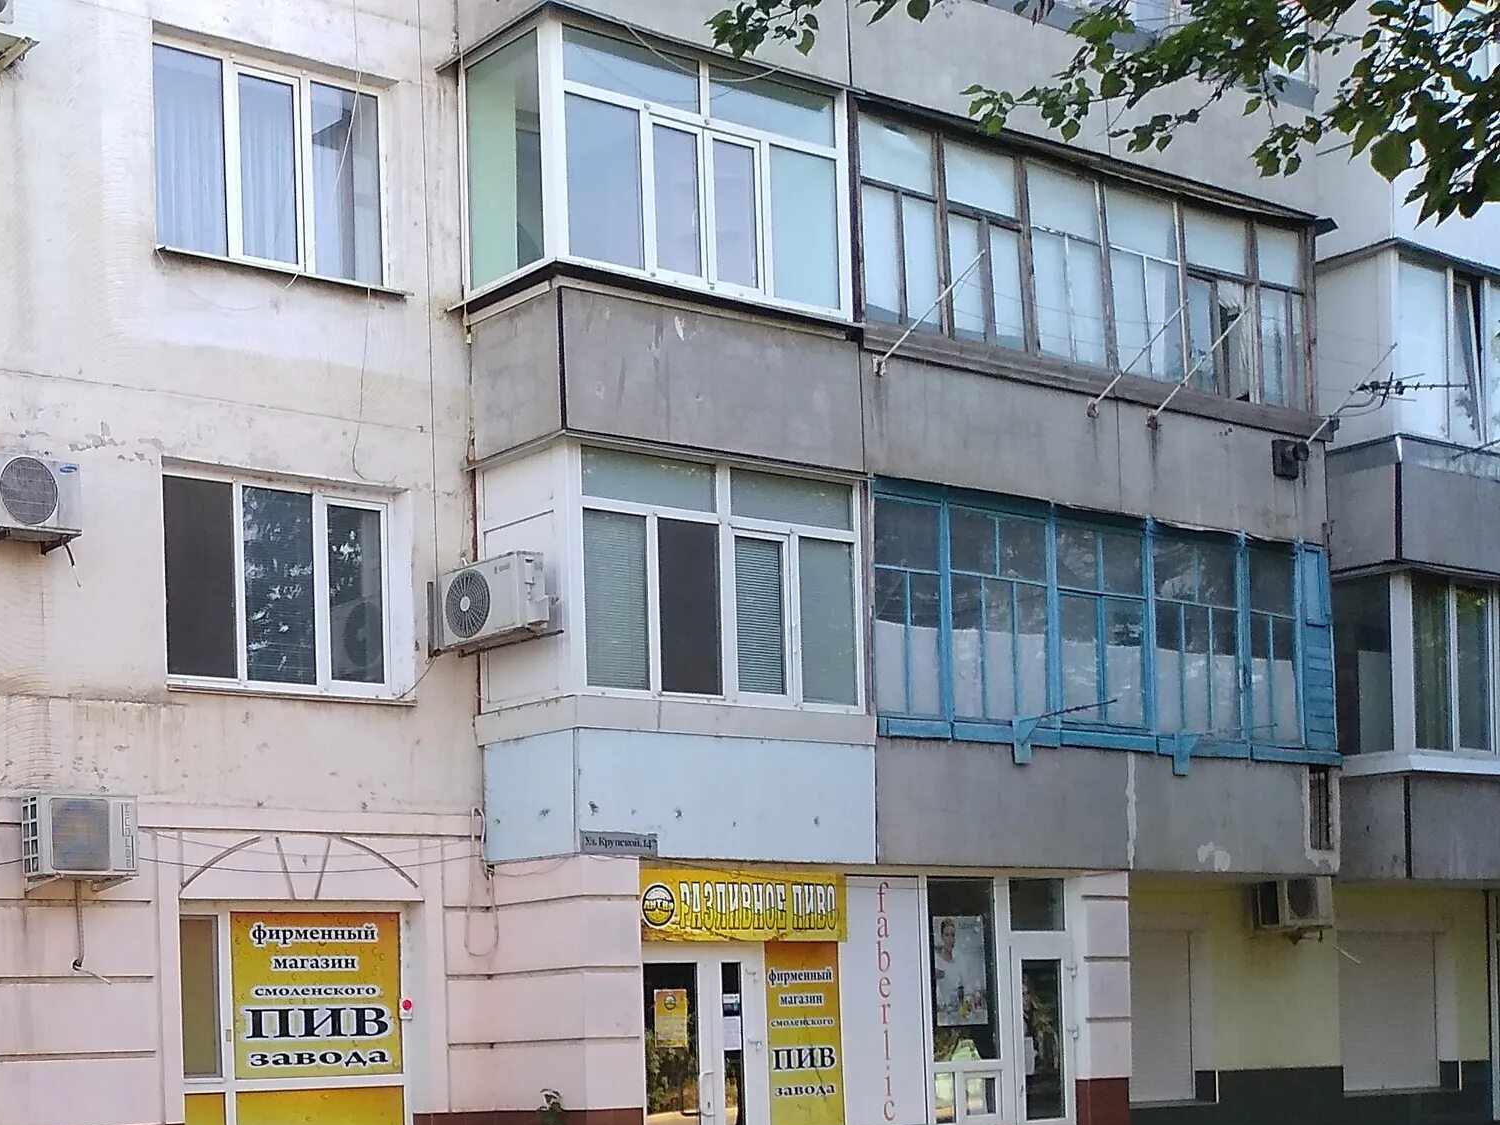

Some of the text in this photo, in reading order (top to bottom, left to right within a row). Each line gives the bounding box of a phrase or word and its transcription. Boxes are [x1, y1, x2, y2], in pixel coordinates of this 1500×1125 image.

[584, 836, 597, 846] Ул.
[678, 881, 787, 930] РАЗЛИВНОЕ
[791, 882, 837, 931] ПИВО
[252, 925, 376, 945] фирменный
[273, 958, 357, 969] магазин
[768, 969, 832, 986] фирменный
[254, 986, 377, 997] смоленского
[779, 995, 823, 1005] магазин
[876, 881, 896, 1122] faberlic
[245, 1007, 389, 1039] ПИВ
[770, 1018, 834, 1028] смоленского
[250, 1050, 389, 1067] завода
[773, 1047, 836, 1070] ПИВ
[774, 1084, 836, 1097] завода
